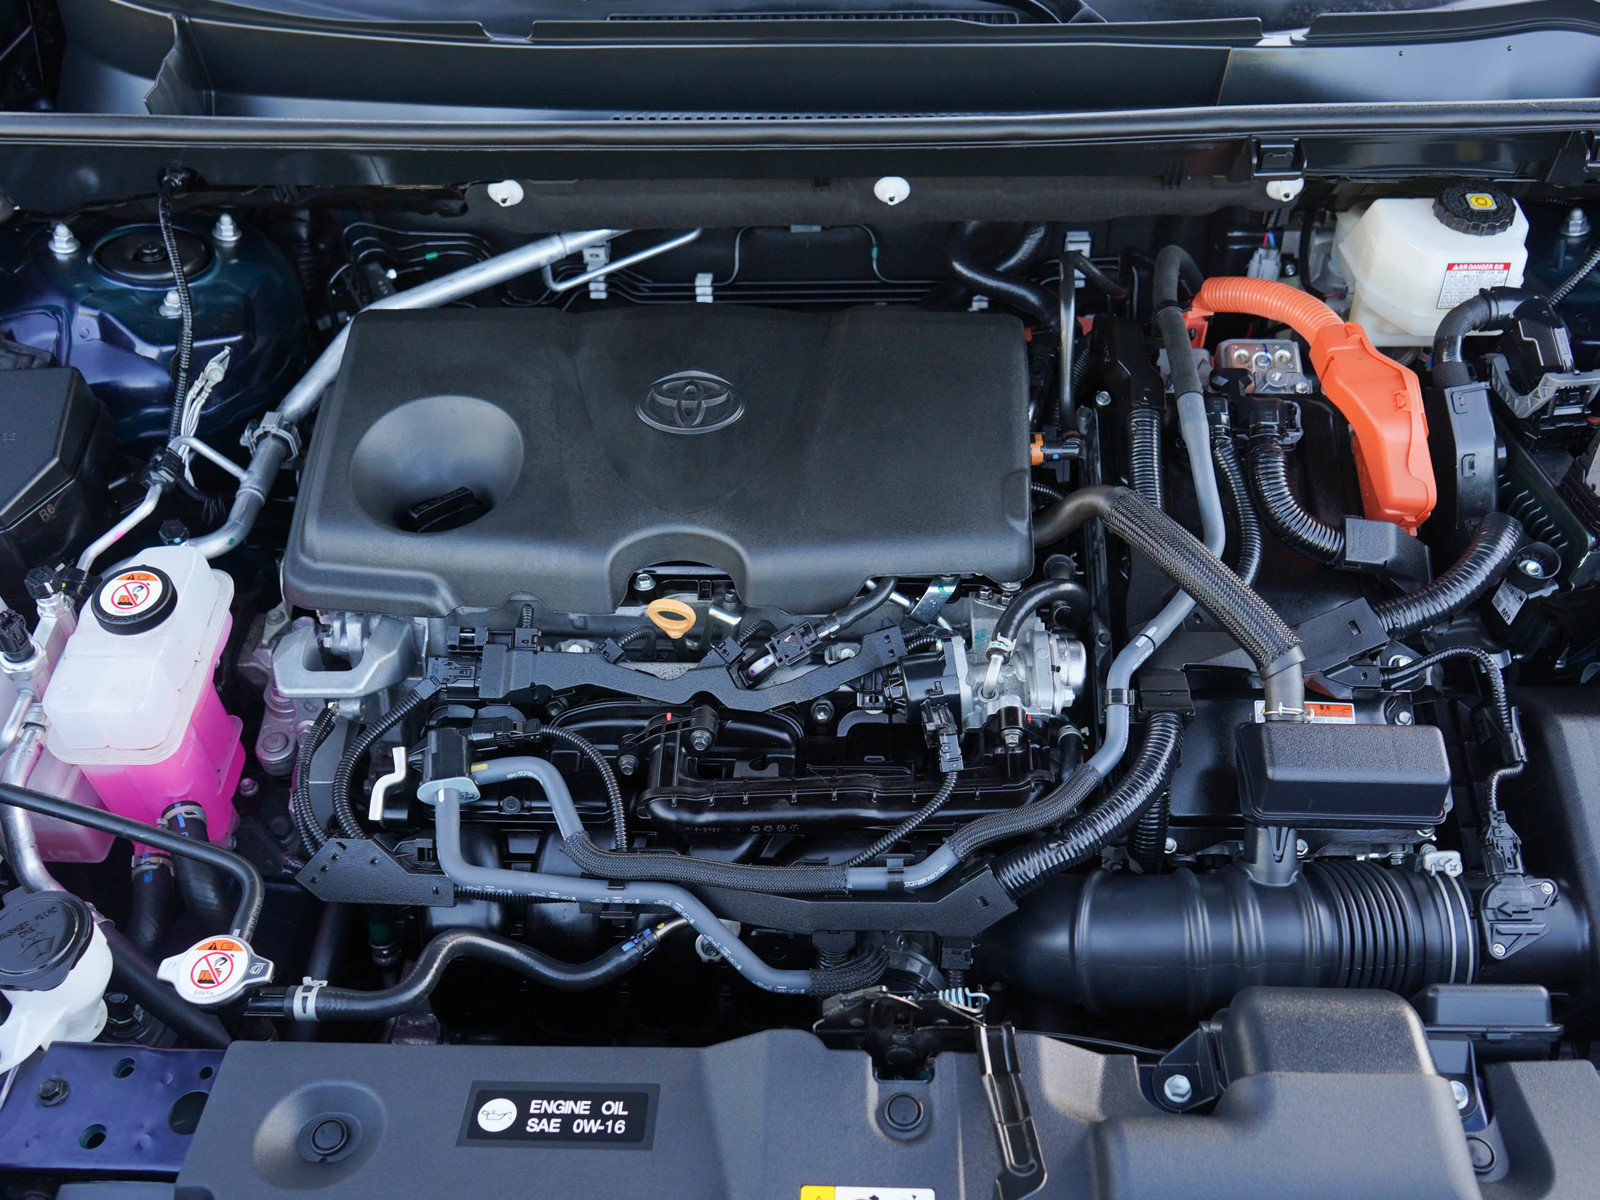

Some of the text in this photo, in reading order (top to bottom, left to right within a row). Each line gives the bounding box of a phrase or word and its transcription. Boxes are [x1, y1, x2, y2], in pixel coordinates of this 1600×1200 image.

[38, 503, 56, 522] R6
[529, 1099, 629, 1116] ENGINE OIL
[525, 1118, 626, 1134] SAE 0W-16
